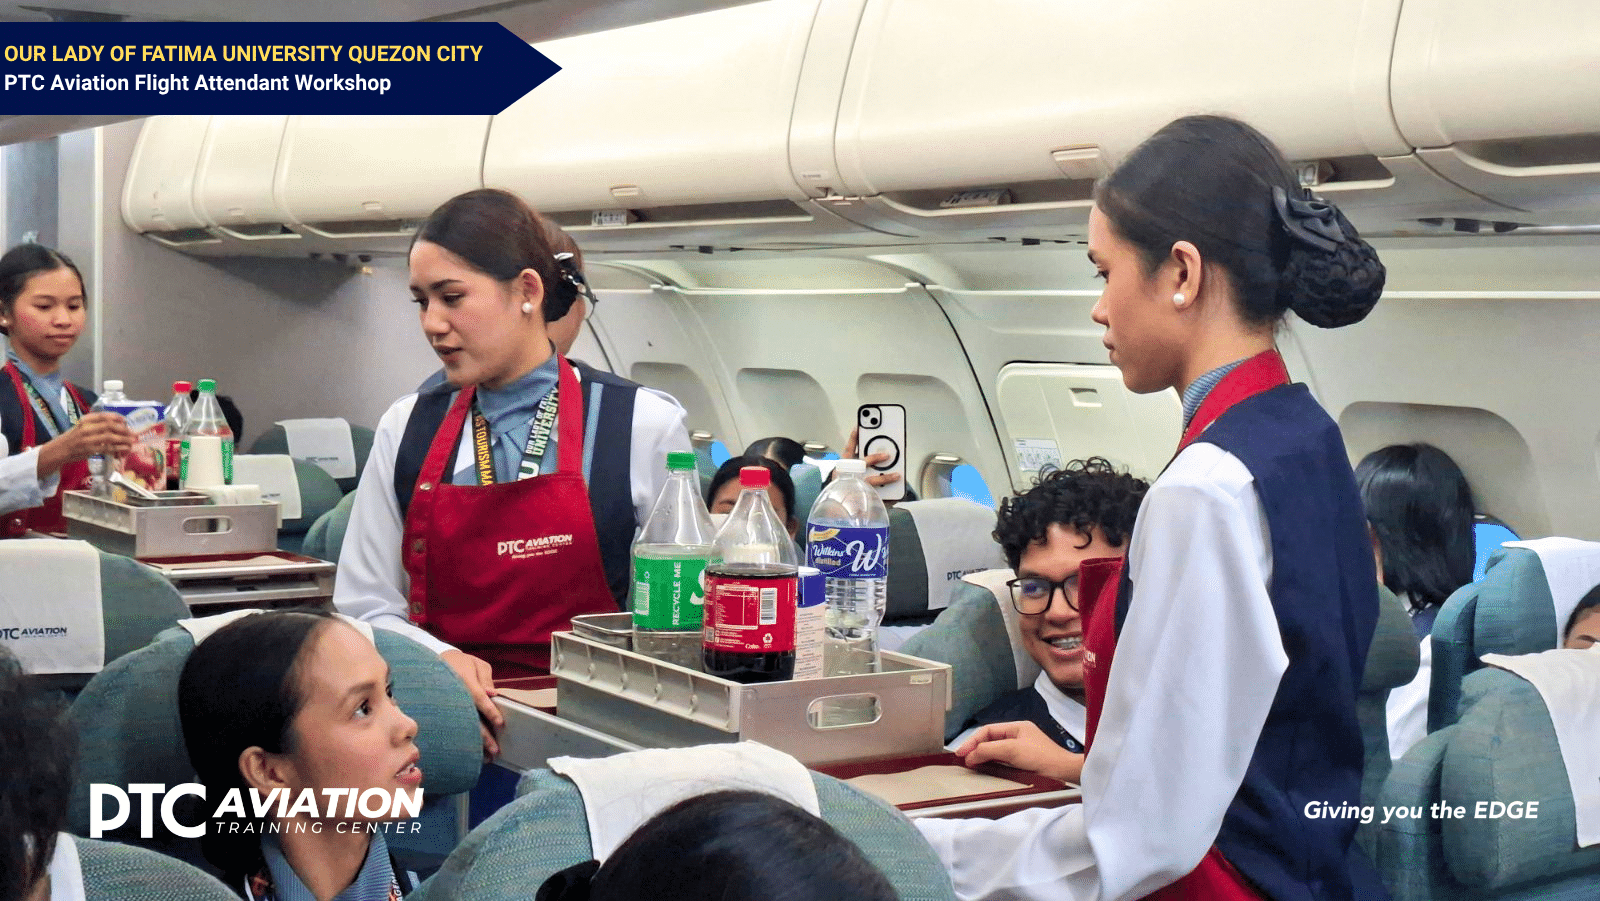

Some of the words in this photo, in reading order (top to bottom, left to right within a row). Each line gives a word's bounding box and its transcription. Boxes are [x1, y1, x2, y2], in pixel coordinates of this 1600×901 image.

[532, 387, 559, 456] UNIVERSITY
[475, 426, 491, 470] TOURISM
[497, 539, 525, 556] PTC
[525, 534, 573, 547] AVIATION
[812, 543, 845, 557] Wilkins
[673, 561, 682, 578] ME
[672, 580, 681, 626] RECYCLE
[0, 627, 20, 640] TC
[21, 627, 67, 635] AVIATION
